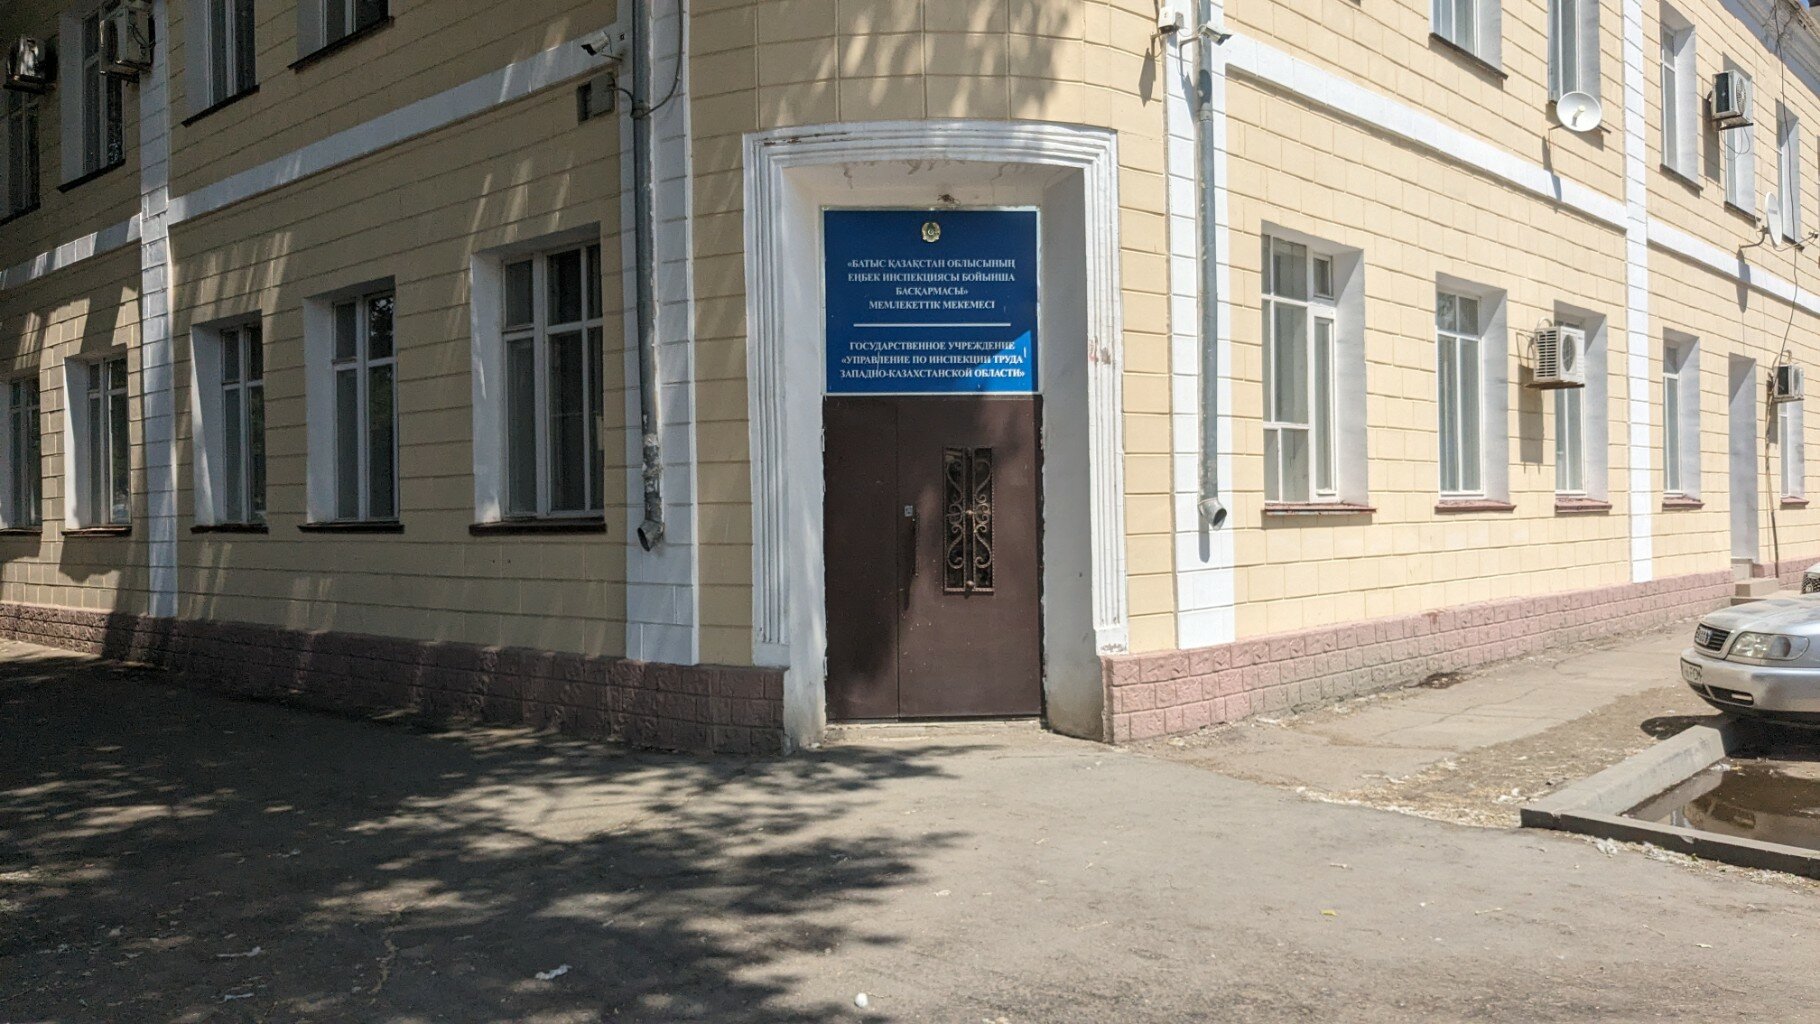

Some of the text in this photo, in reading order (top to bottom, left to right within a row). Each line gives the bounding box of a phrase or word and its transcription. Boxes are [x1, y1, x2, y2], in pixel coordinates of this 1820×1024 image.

[888, 259, 946, 270] ҚАЗАҚСТАН
[947, 259, 1016, 269] ОБЛЫСЫНЫҢ
[848, 271, 1015, 283] ЕҢБЕК ИНСПЕКЦИЯСЫ БОЙЫНША
[895, 287, 968, 297] БАСҚАРМАСЫ»
[869, 301, 995, 310] МЕМЛЕКЕТТІК МЕКЕМЕСІ
[849, 341, 1015, 351] ГОСУДАРСТВЕННОЕ УЧРЕЖДЕНИЕ
[841, 355, 1023, 365] «УПРАВЛЕНИЕ ПО ИНСПЕКЦИИ ТРУДА
[840, 368, 1025, 379] ЗАПАДНО-КАЗАХСТАНСКОЙ ОБЛАСТИ»
